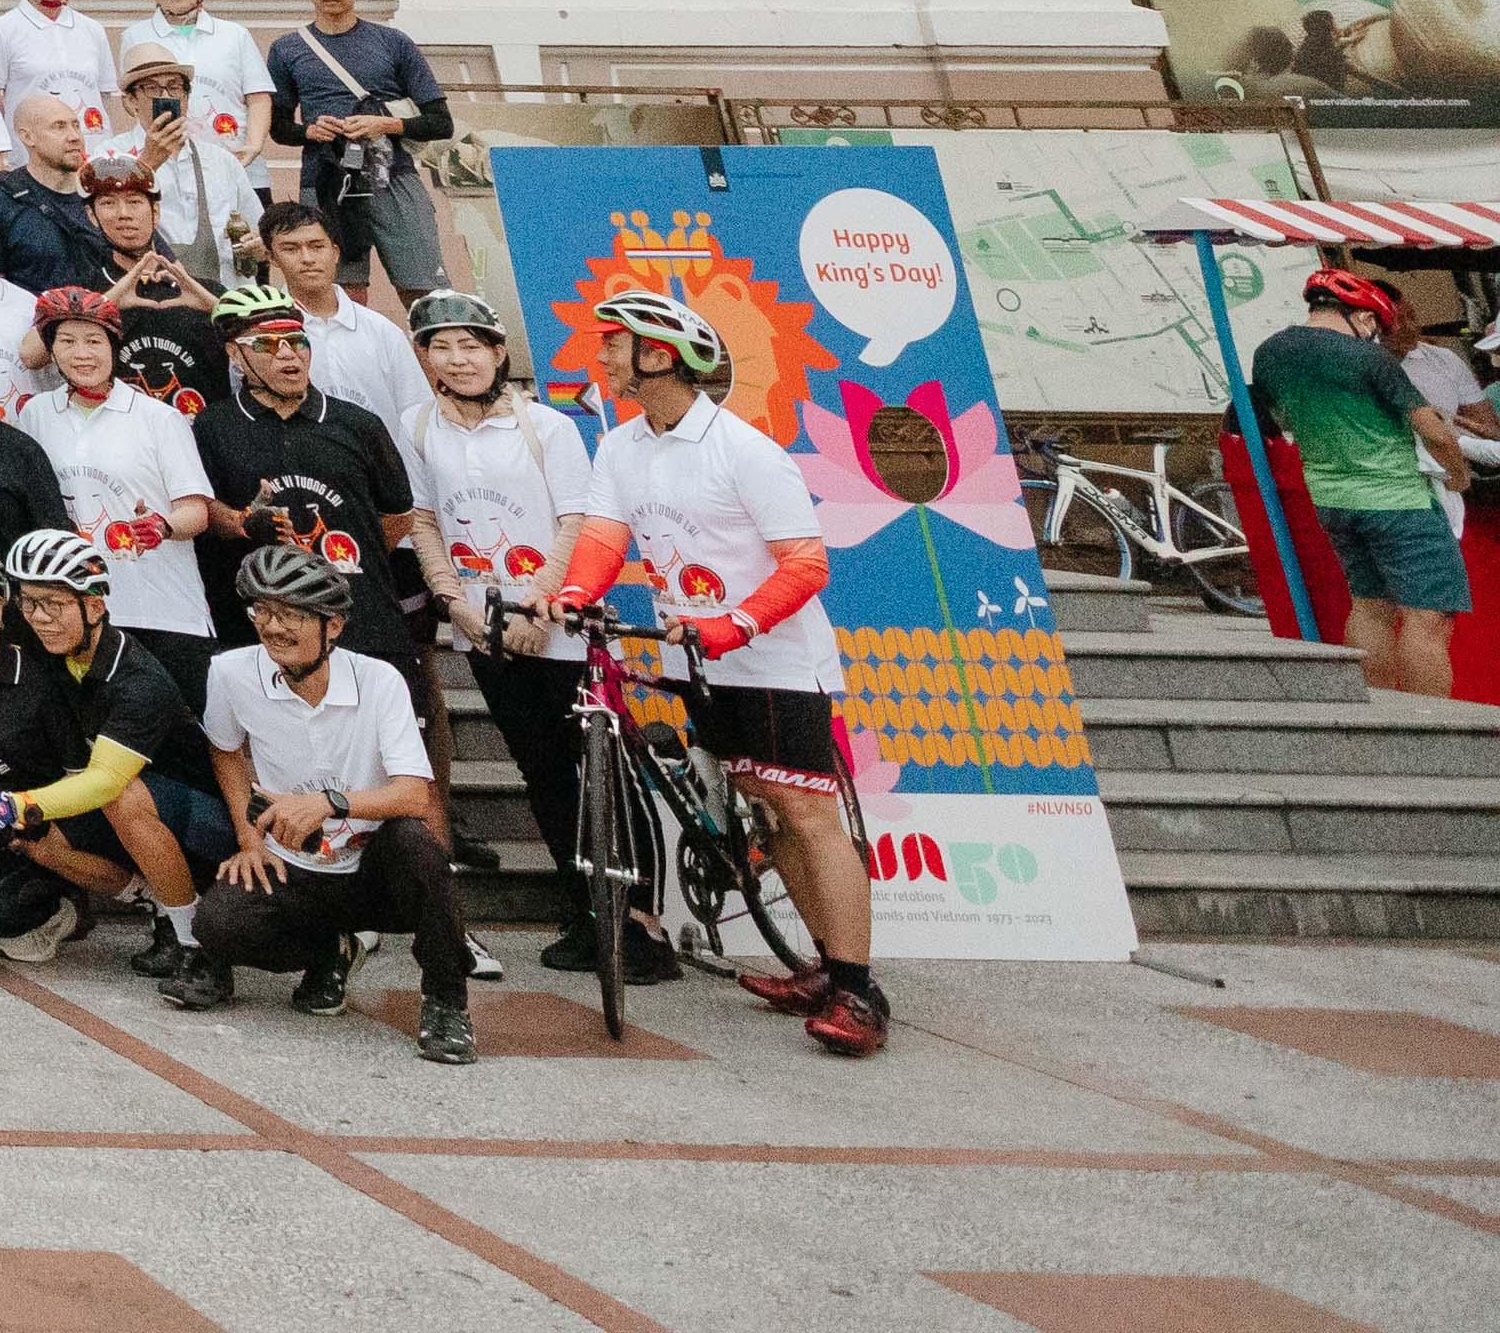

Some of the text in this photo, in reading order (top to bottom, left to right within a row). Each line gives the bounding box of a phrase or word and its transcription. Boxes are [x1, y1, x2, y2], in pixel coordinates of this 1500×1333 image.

[833, 228, 910, 254] Happy
[816, 262, 942, 289] King's Day!
[1027, 800, 1093, 815] #NLVN50
[892, 889, 946, 904] relations
[906, 909, 1053, 926] and Vietnam 1973 2023
